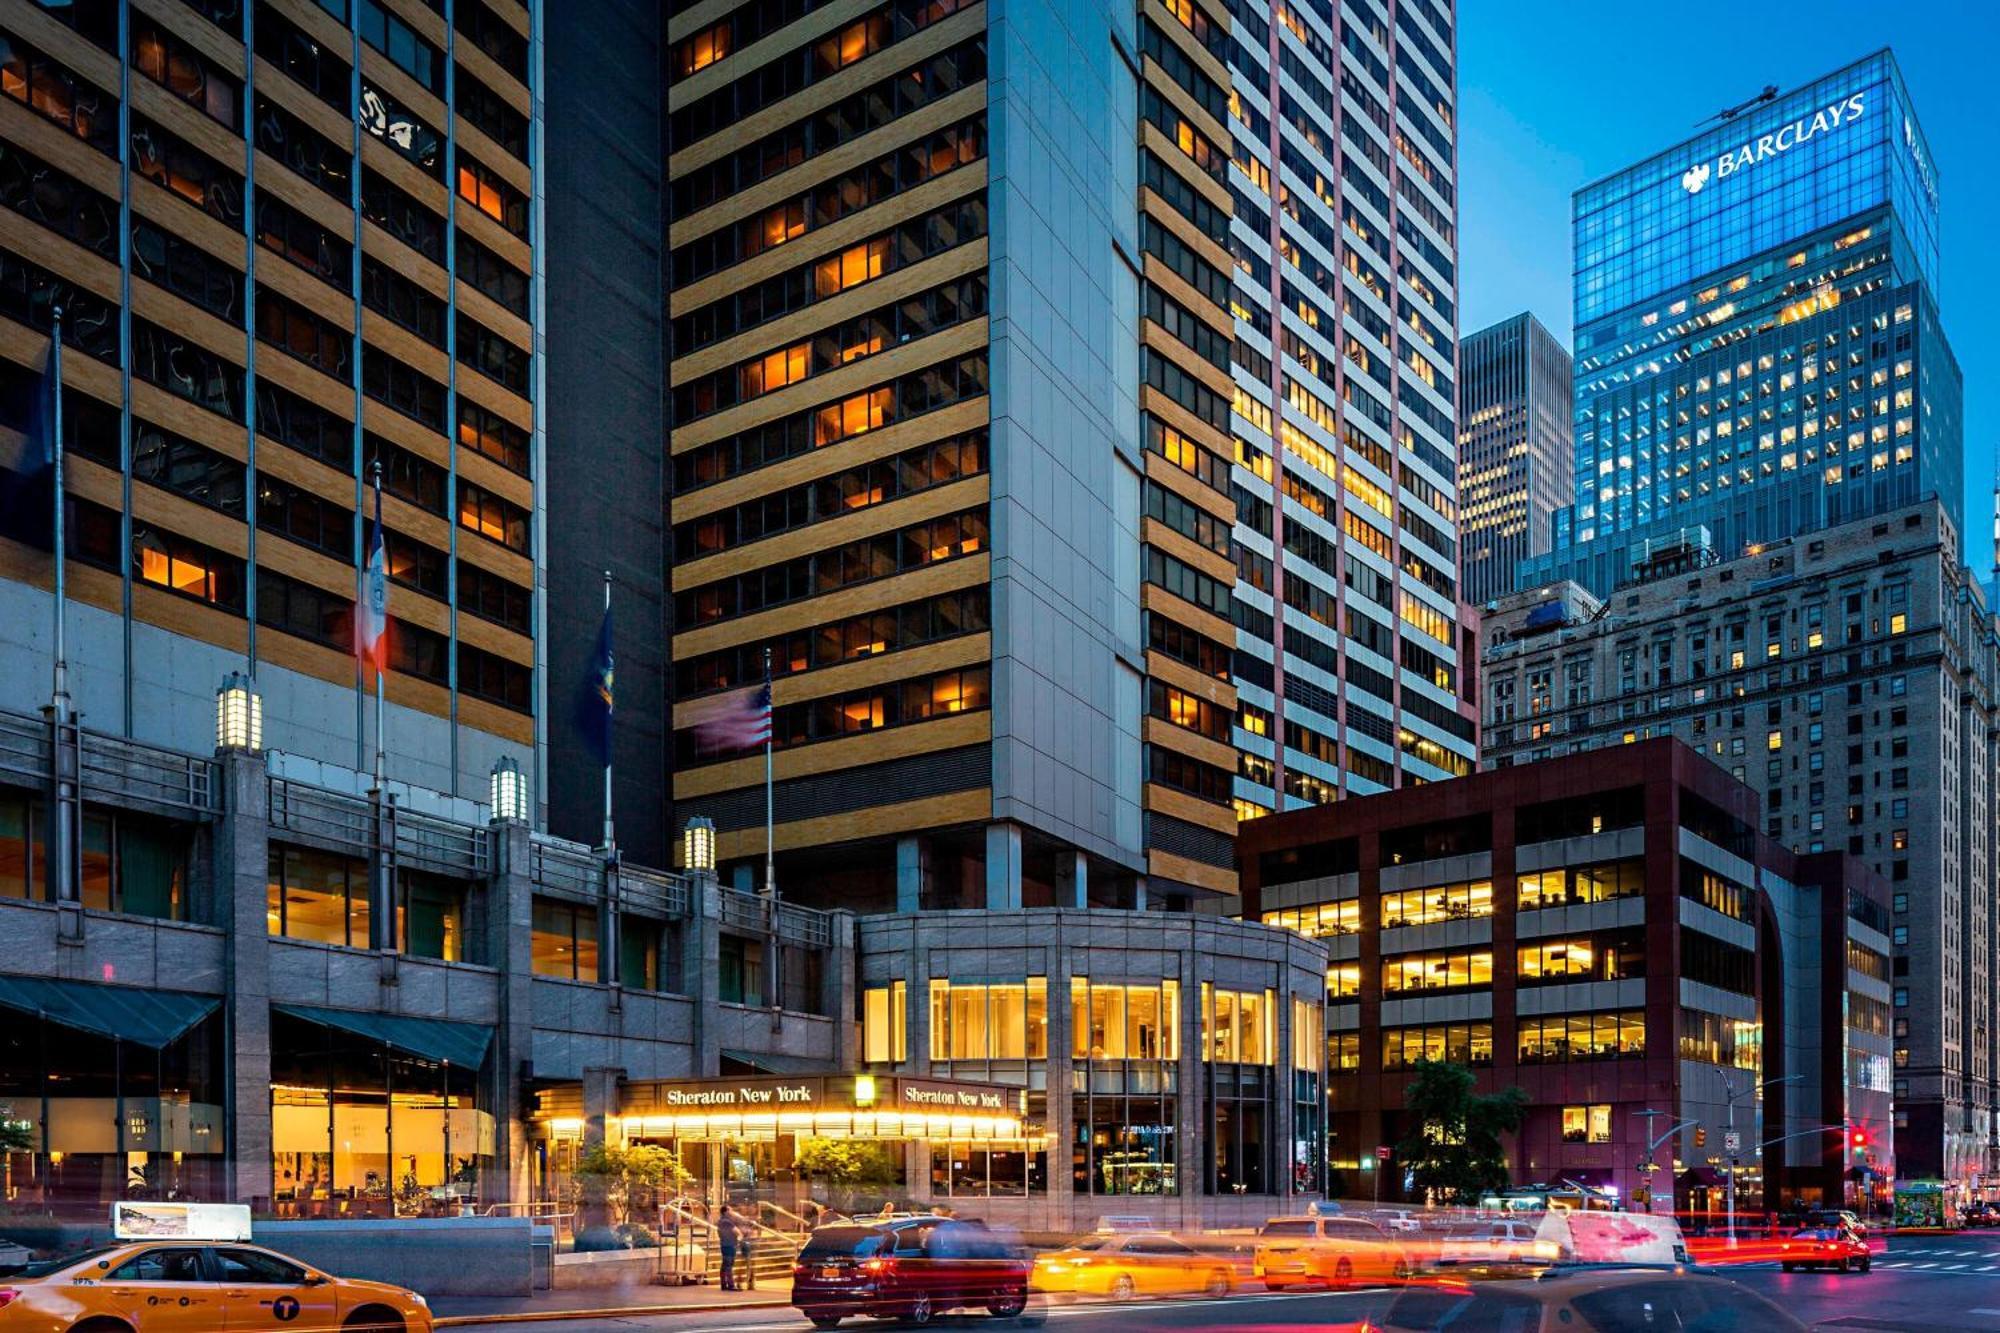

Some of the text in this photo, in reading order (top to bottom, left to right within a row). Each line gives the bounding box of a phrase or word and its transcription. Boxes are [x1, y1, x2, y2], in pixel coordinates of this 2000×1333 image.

[1717, 93, 1864, 178] BARCLAYS
[667, 1086, 811, 1105] Sheraton New York
[905, 1087, 1002, 1108] Sheraton New York
